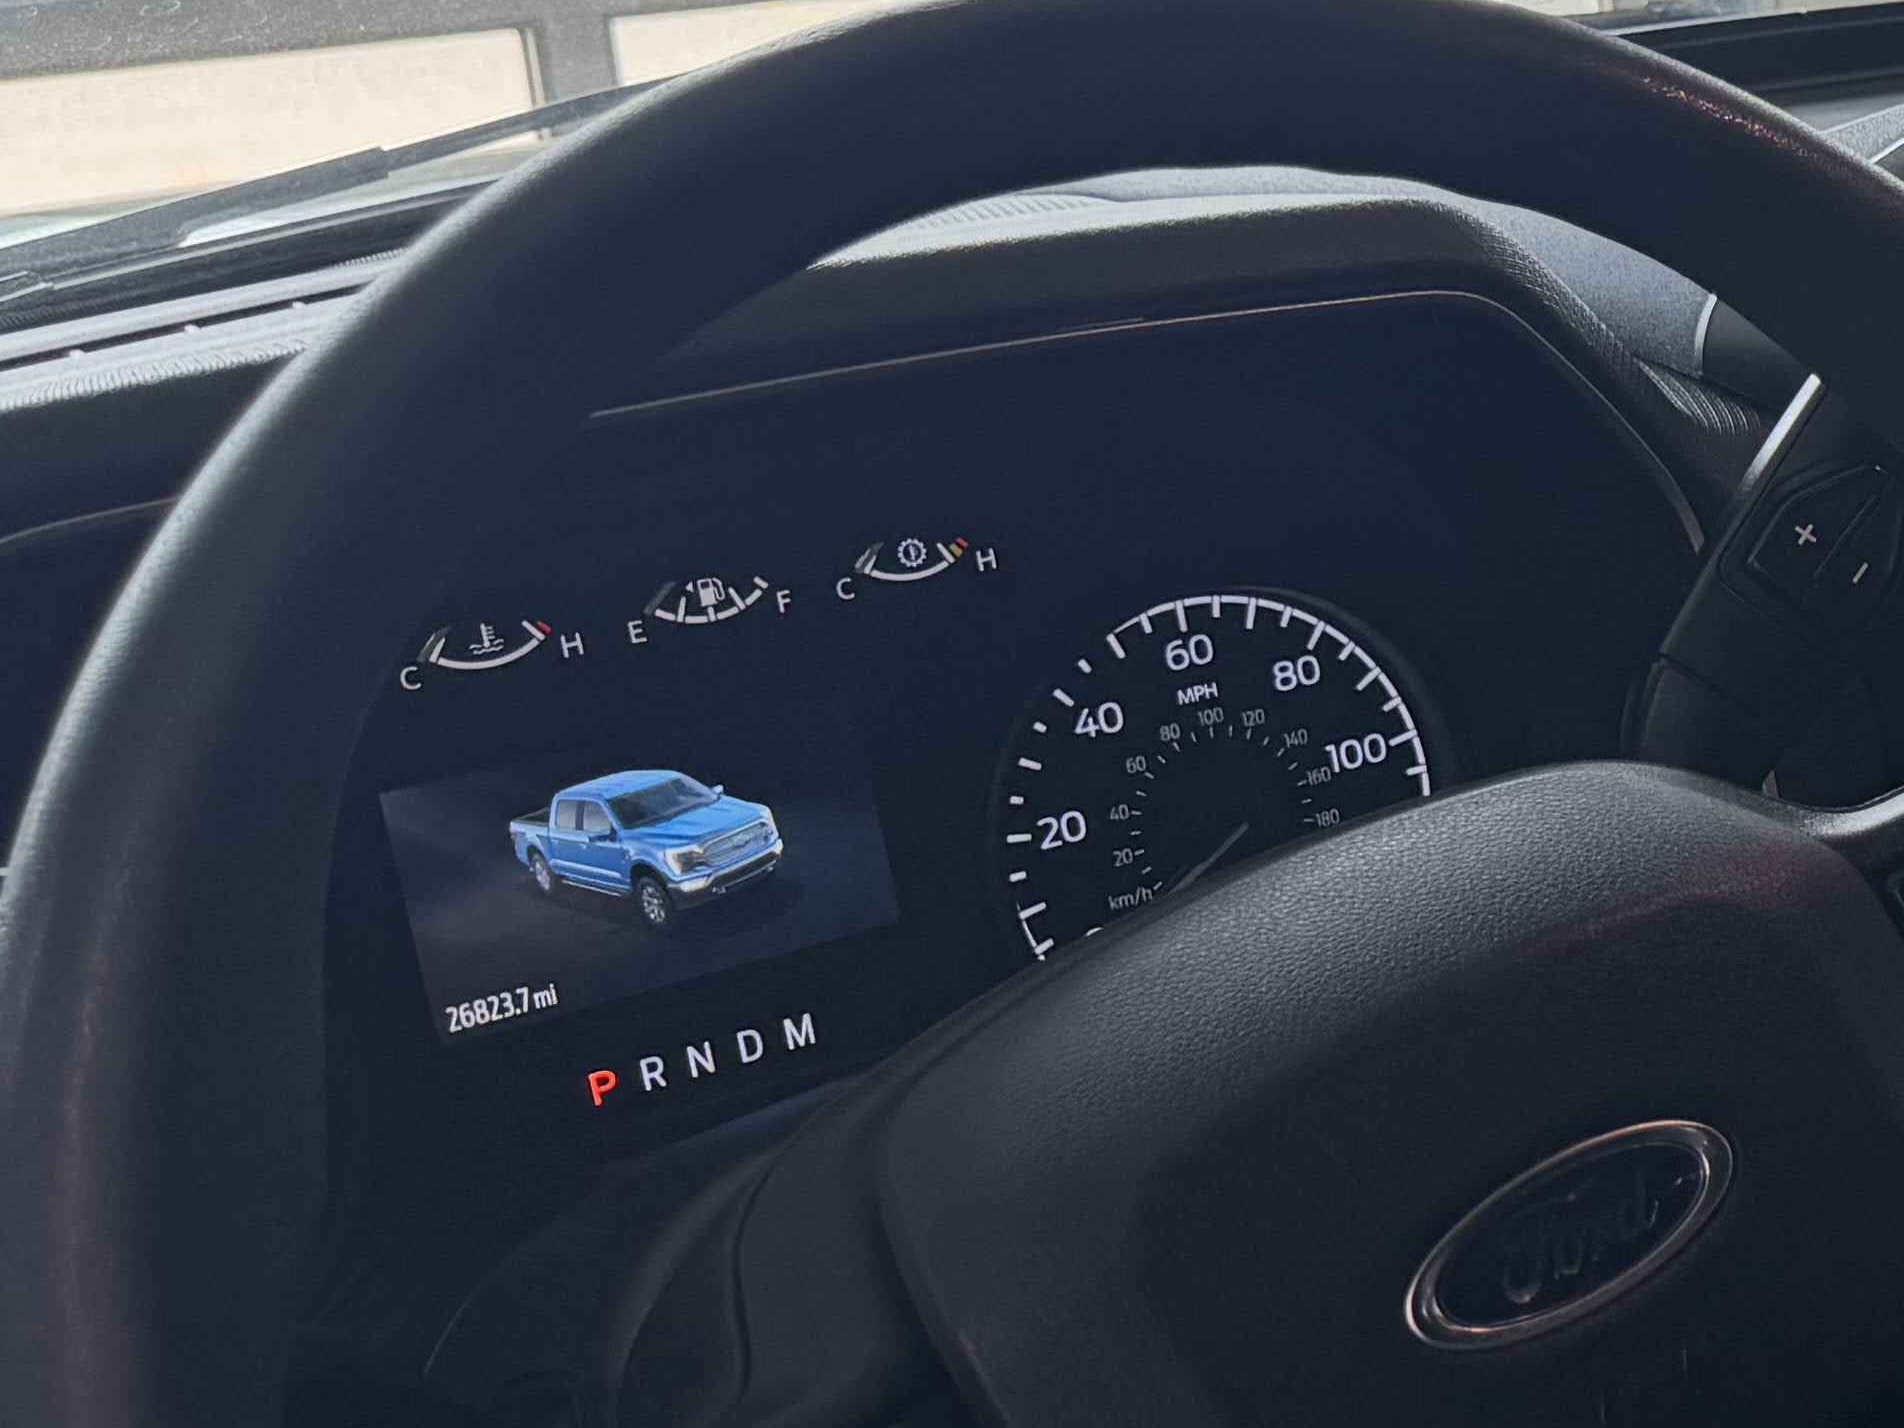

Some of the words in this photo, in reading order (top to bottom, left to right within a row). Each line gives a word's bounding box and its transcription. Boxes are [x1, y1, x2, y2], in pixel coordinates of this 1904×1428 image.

[975, 547, 997, 572] H
[776, 588, 793, 613] F
[837, 577, 855, 600] C
[627, 619, 648, 644] E
[560, 632, 584, 659] H
[1166, 634, 1214, 671] 60
[399, 665, 422, 690] C
[1273, 655, 1321, 692] 80
[1177, 682, 1219, 707] MPH
[1073, 701, 1124, 738] 40
[1198, 707, 1224, 726] 100
[1242, 708, 1266, 728] 120
[1160, 723, 1181, 742] 80
[1283, 728, 1308, 747] 140
[1126, 756, 1147, 775] 60
[1323, 733, 1388, 773] 100
[1109, 803, 1131, 821] 40
[1315, 808, 1340, 827] 180
[1036, 810, 1087, 850] 20
[1112, 847, 1134, 867] 20
[1108, 886, 1154, 910] km/h
[445, 987, 529, 1033] 26823.7
[532, 983, 558, 1009] mi
[587, 1070, 617, 1107] P
[640, 1056, 667, 1092] R
[686, 1041, 716, 1078] N
[737, 1029, 764, 1064] D
[783, 1013, 816, 1050] M
